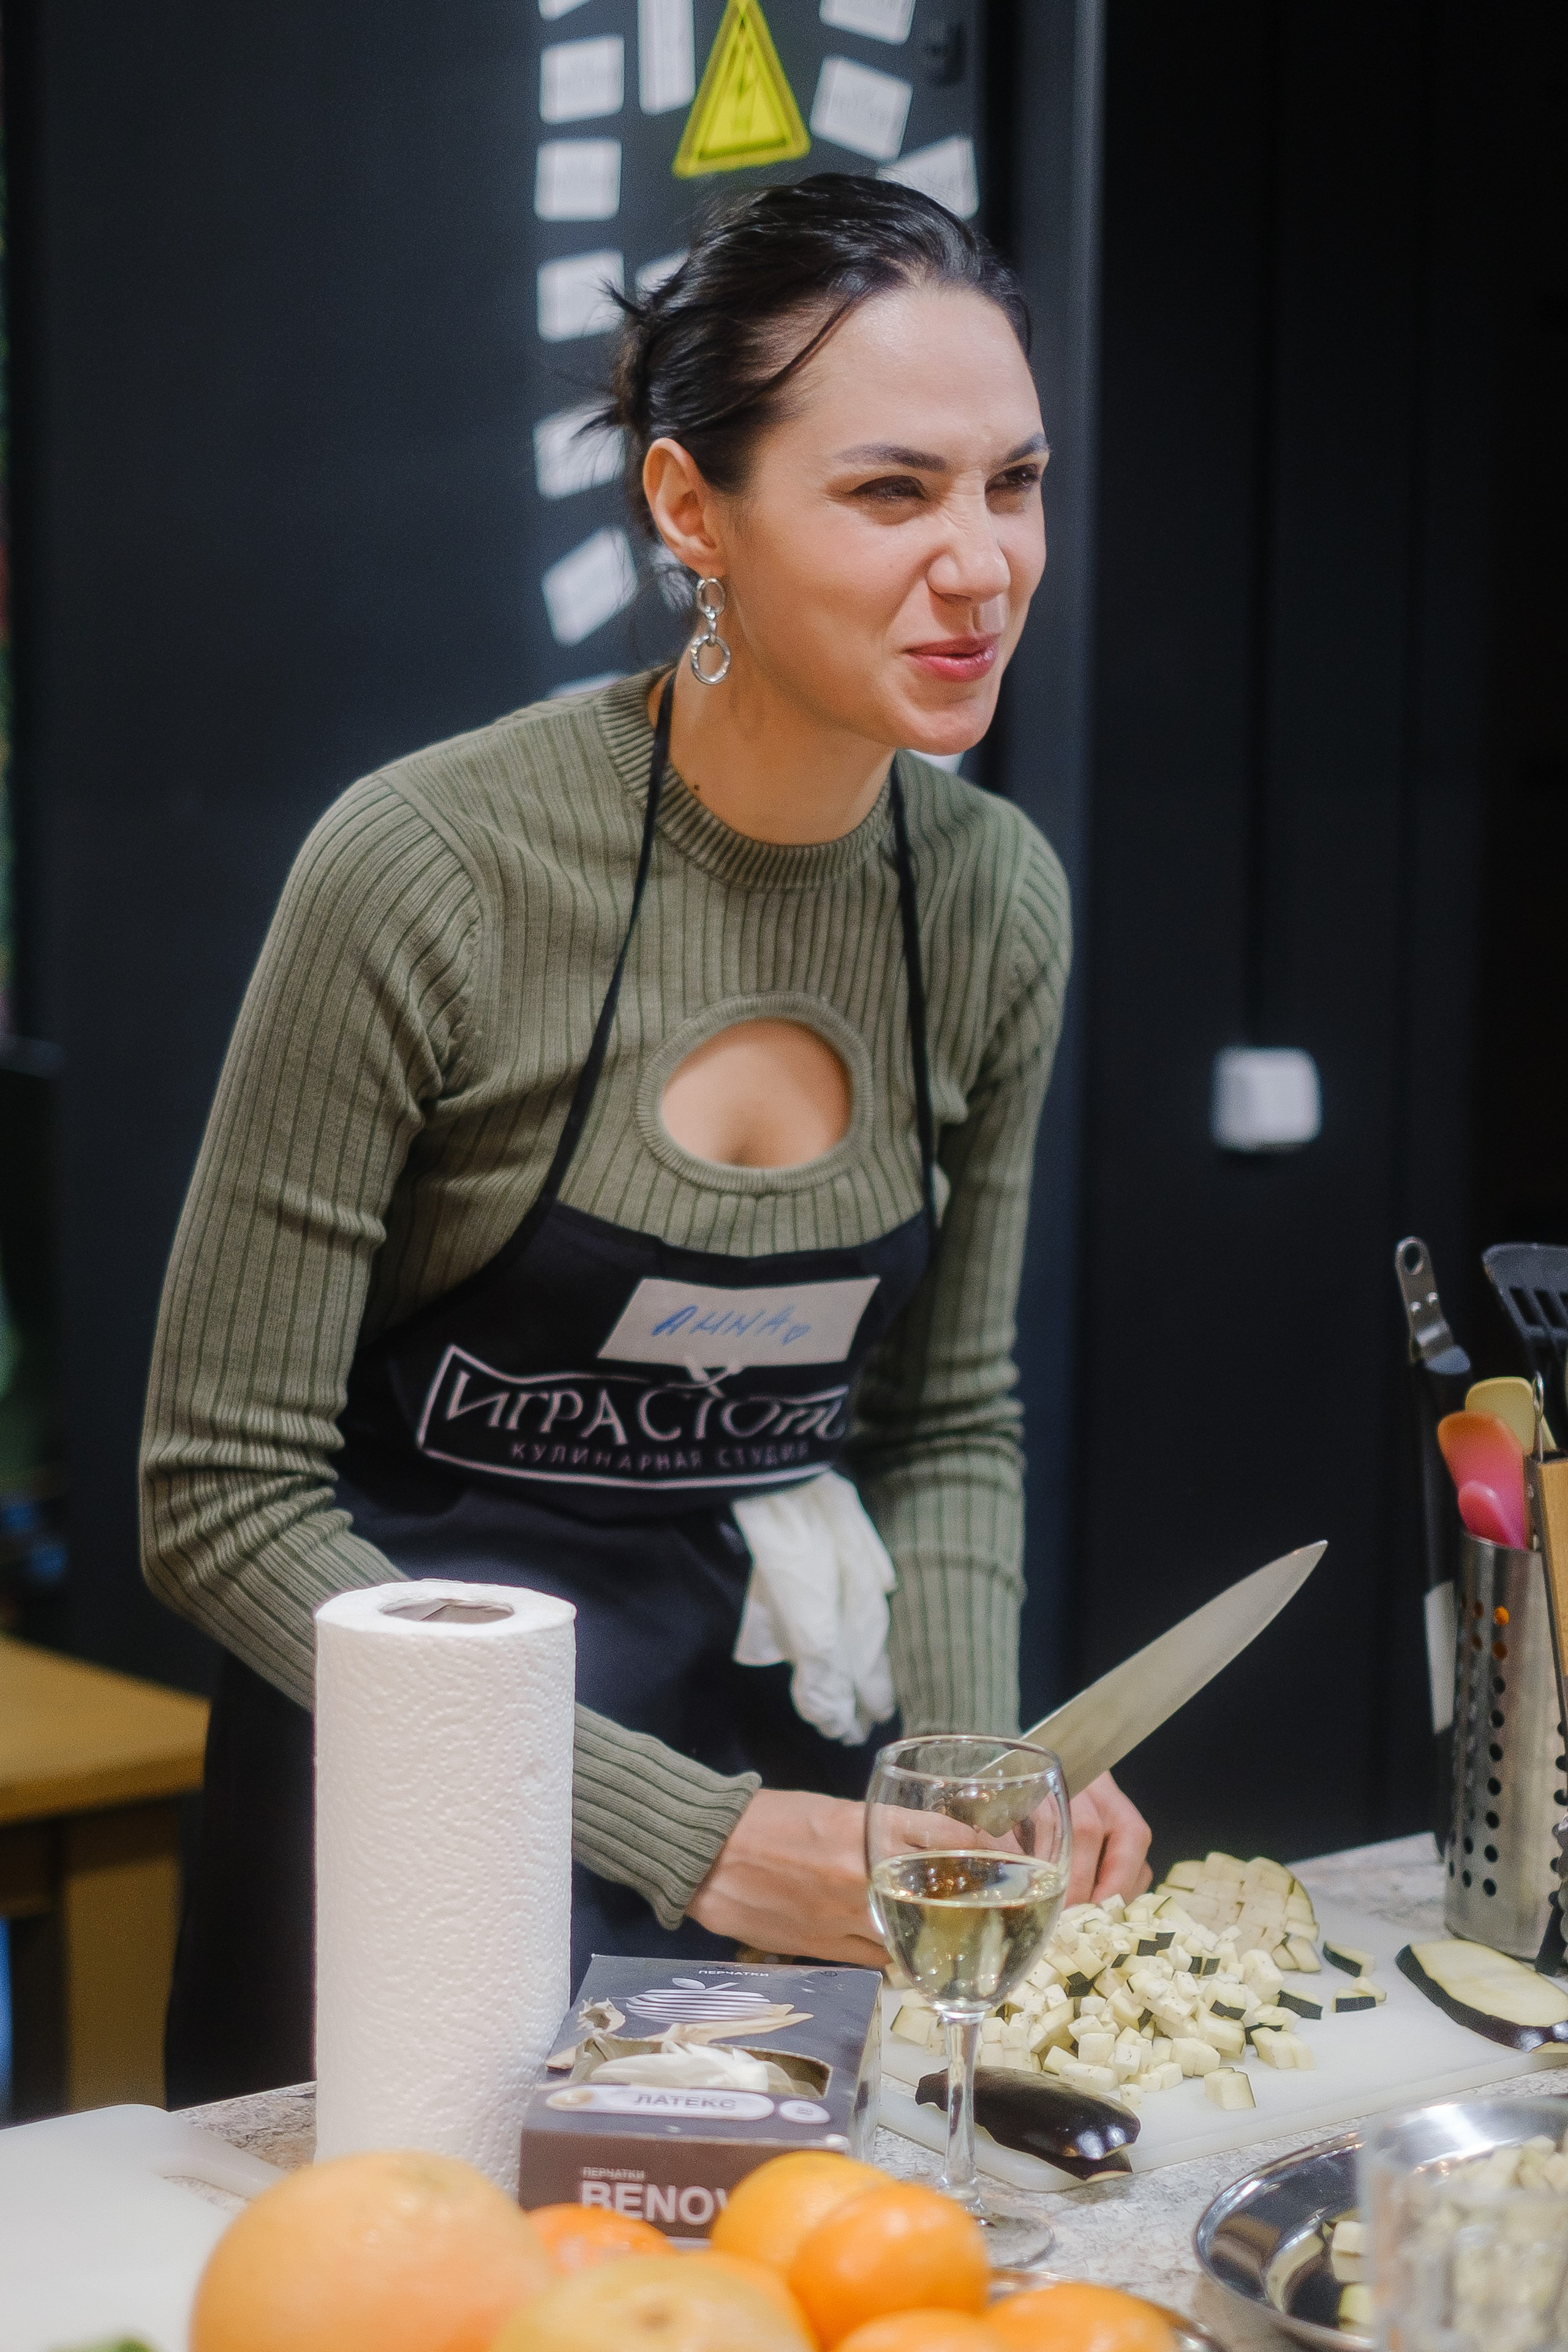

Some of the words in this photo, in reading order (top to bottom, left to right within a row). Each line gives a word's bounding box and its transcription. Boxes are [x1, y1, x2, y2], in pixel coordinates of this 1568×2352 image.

[510, 1441, 703, 1471] КУЛИНАРНАЯ
[715, 1441, 809, 1468] СТУДИЯ
[633, 2092, 737, 2111] ЛАТЕКС
[582, 2166, 646, 2180] ПЕРЧАТКИ
